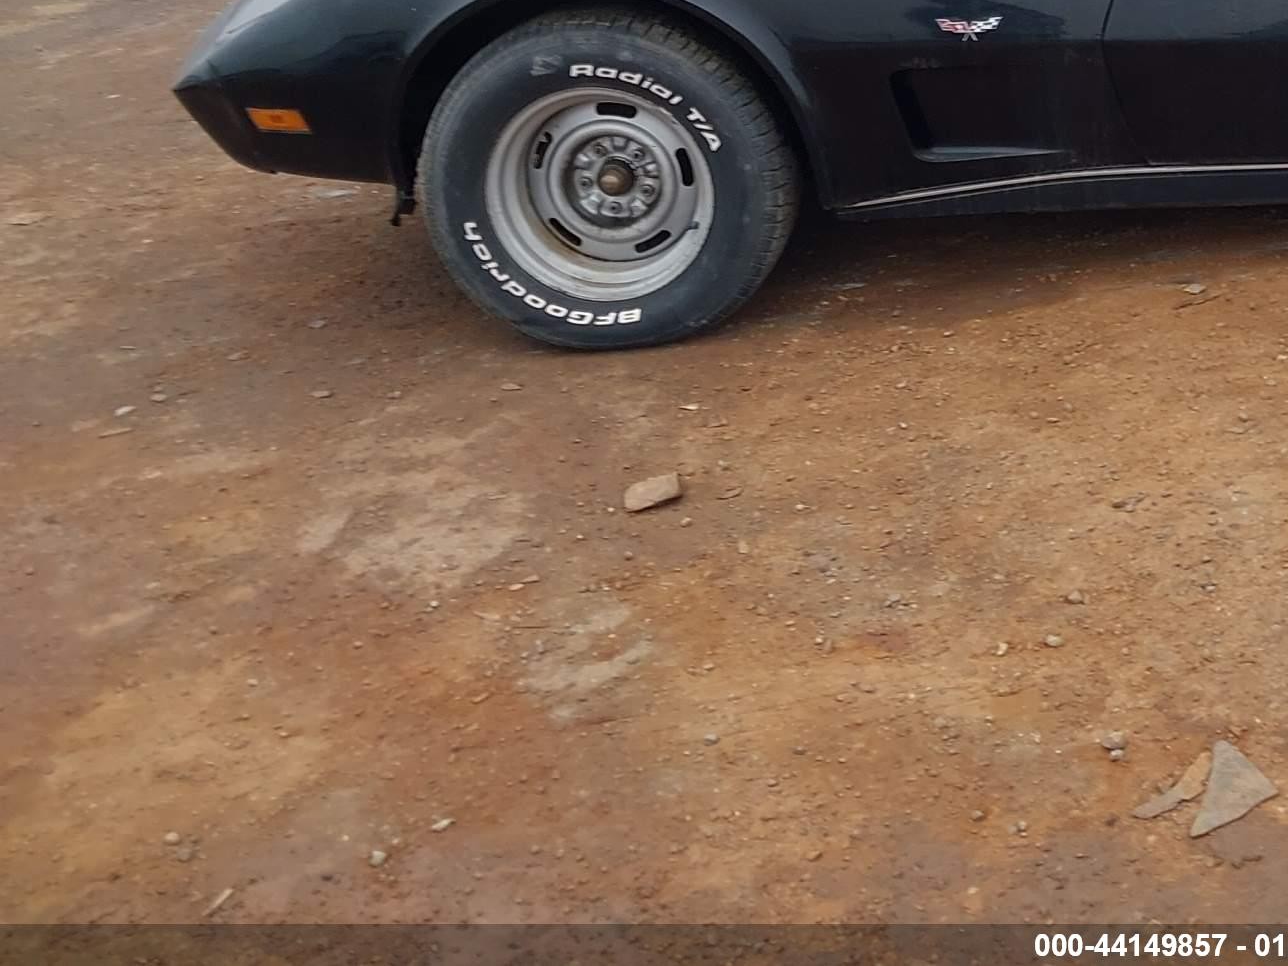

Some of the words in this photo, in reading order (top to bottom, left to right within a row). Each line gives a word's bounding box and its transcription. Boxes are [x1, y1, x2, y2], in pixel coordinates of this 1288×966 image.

[569, 64, 683, 105] Radial
[686, 107, 722, 152] T/A
[463, 221, 642, 326] BFGoodrich
